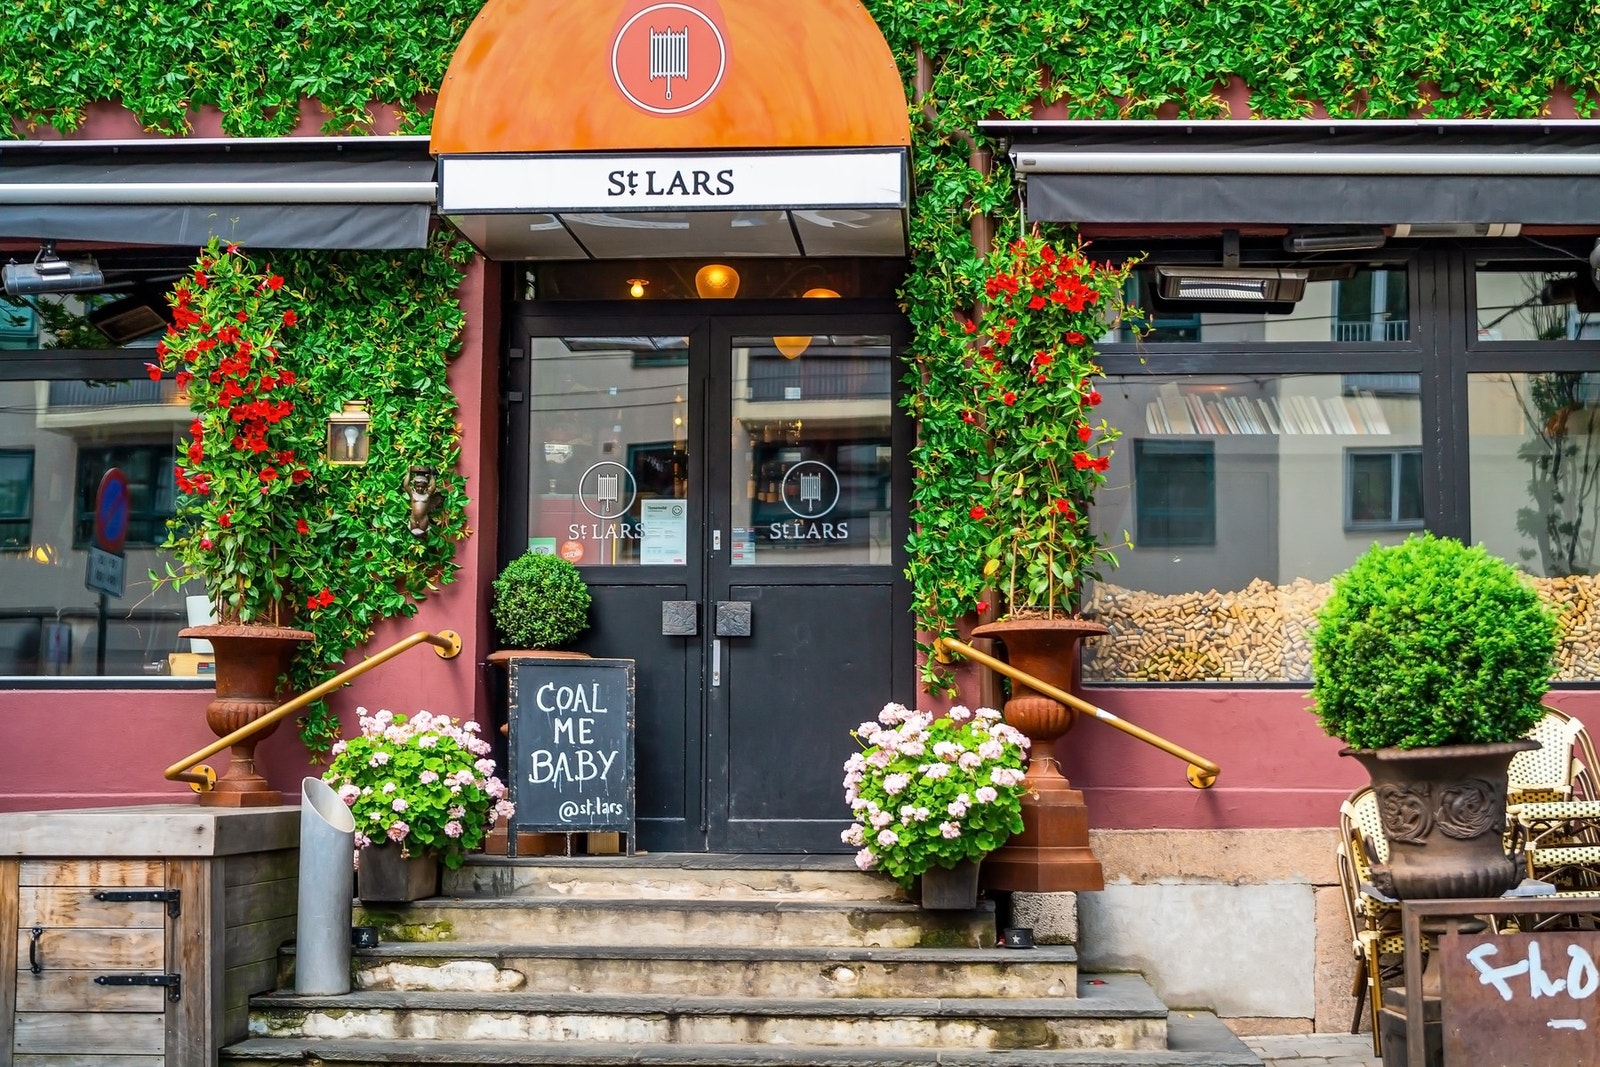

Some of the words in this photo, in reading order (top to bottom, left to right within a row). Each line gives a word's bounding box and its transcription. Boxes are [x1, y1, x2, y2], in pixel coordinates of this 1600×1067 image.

[645, 169, 735, 196] LARS
[592, 522, 646, 540] LARS
[793, 522, 849, 540] LARS
[536, 682, 608, 714] COAL
[553, 717, 595, 745] ME
[528, 749, 619, 784] BABY
